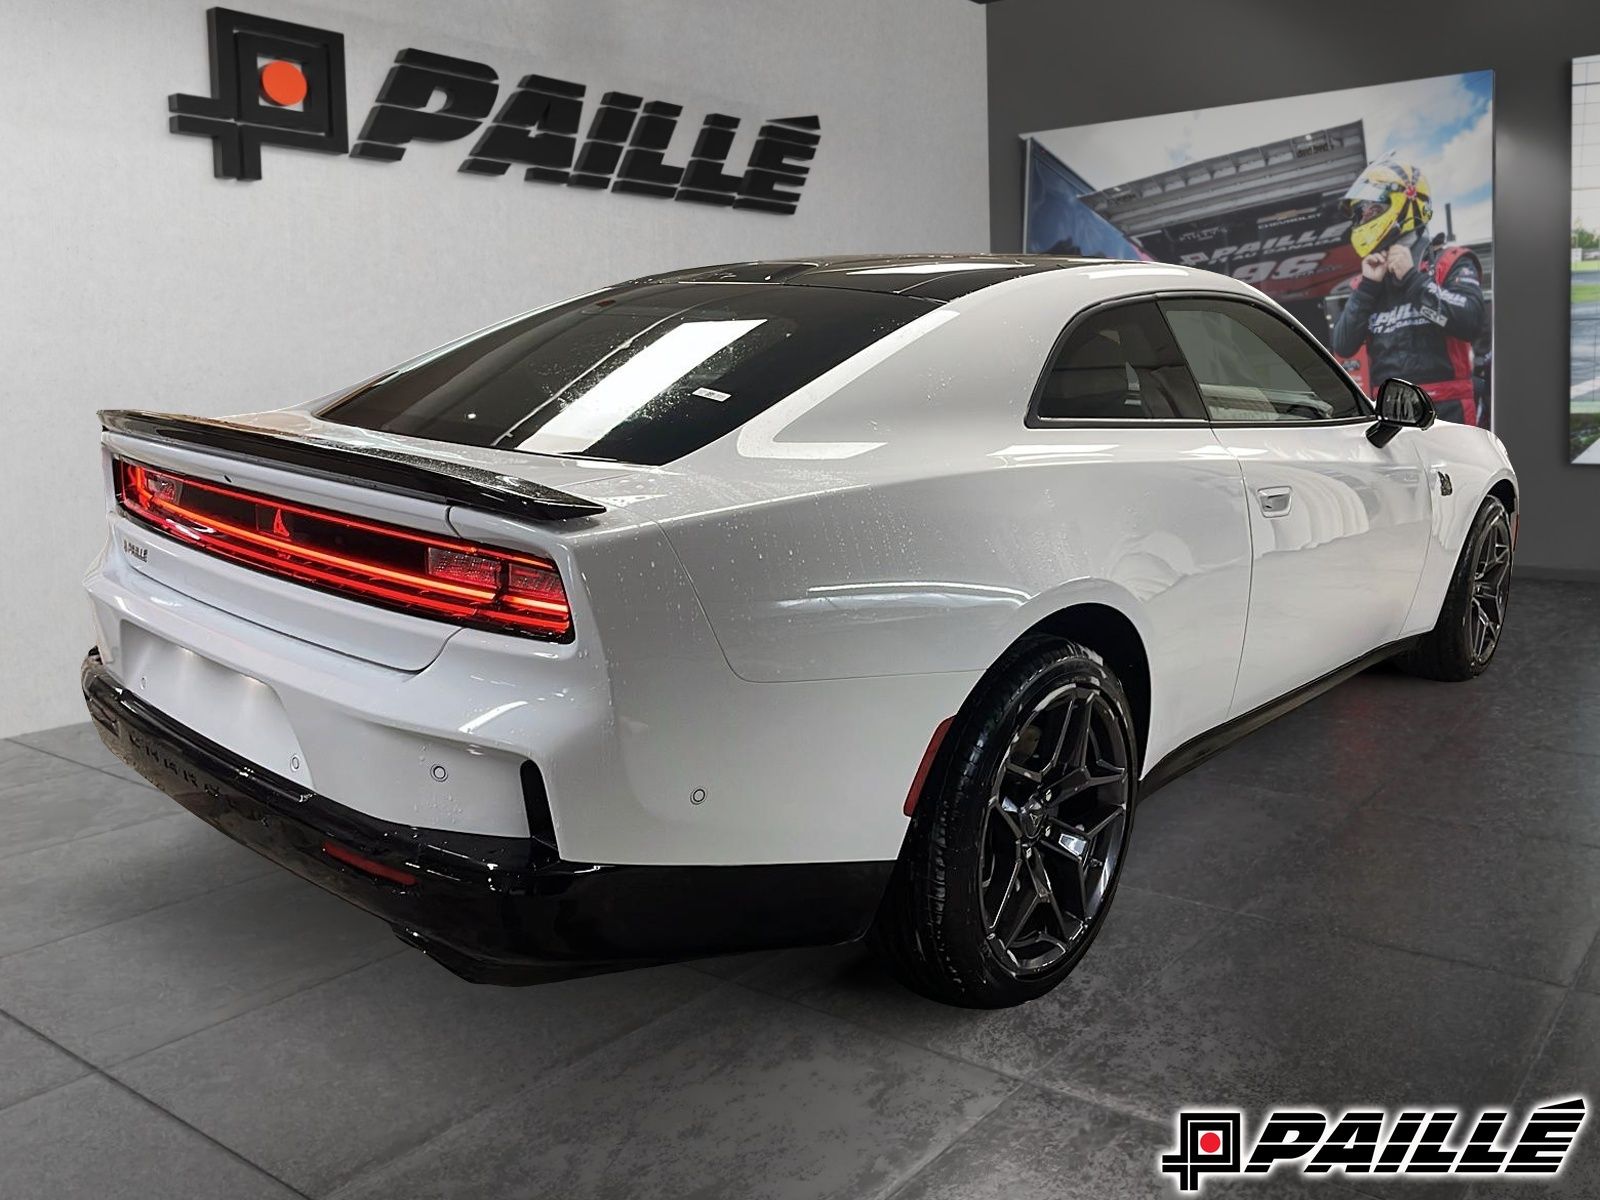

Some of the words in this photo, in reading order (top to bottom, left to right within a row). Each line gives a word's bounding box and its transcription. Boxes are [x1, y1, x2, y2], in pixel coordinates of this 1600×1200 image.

[349, 47, 821, 214] PAILLÉ
[1258, 213, 1322, 229] CHEVROLET
[1232, 252, 1327, 284] 96
